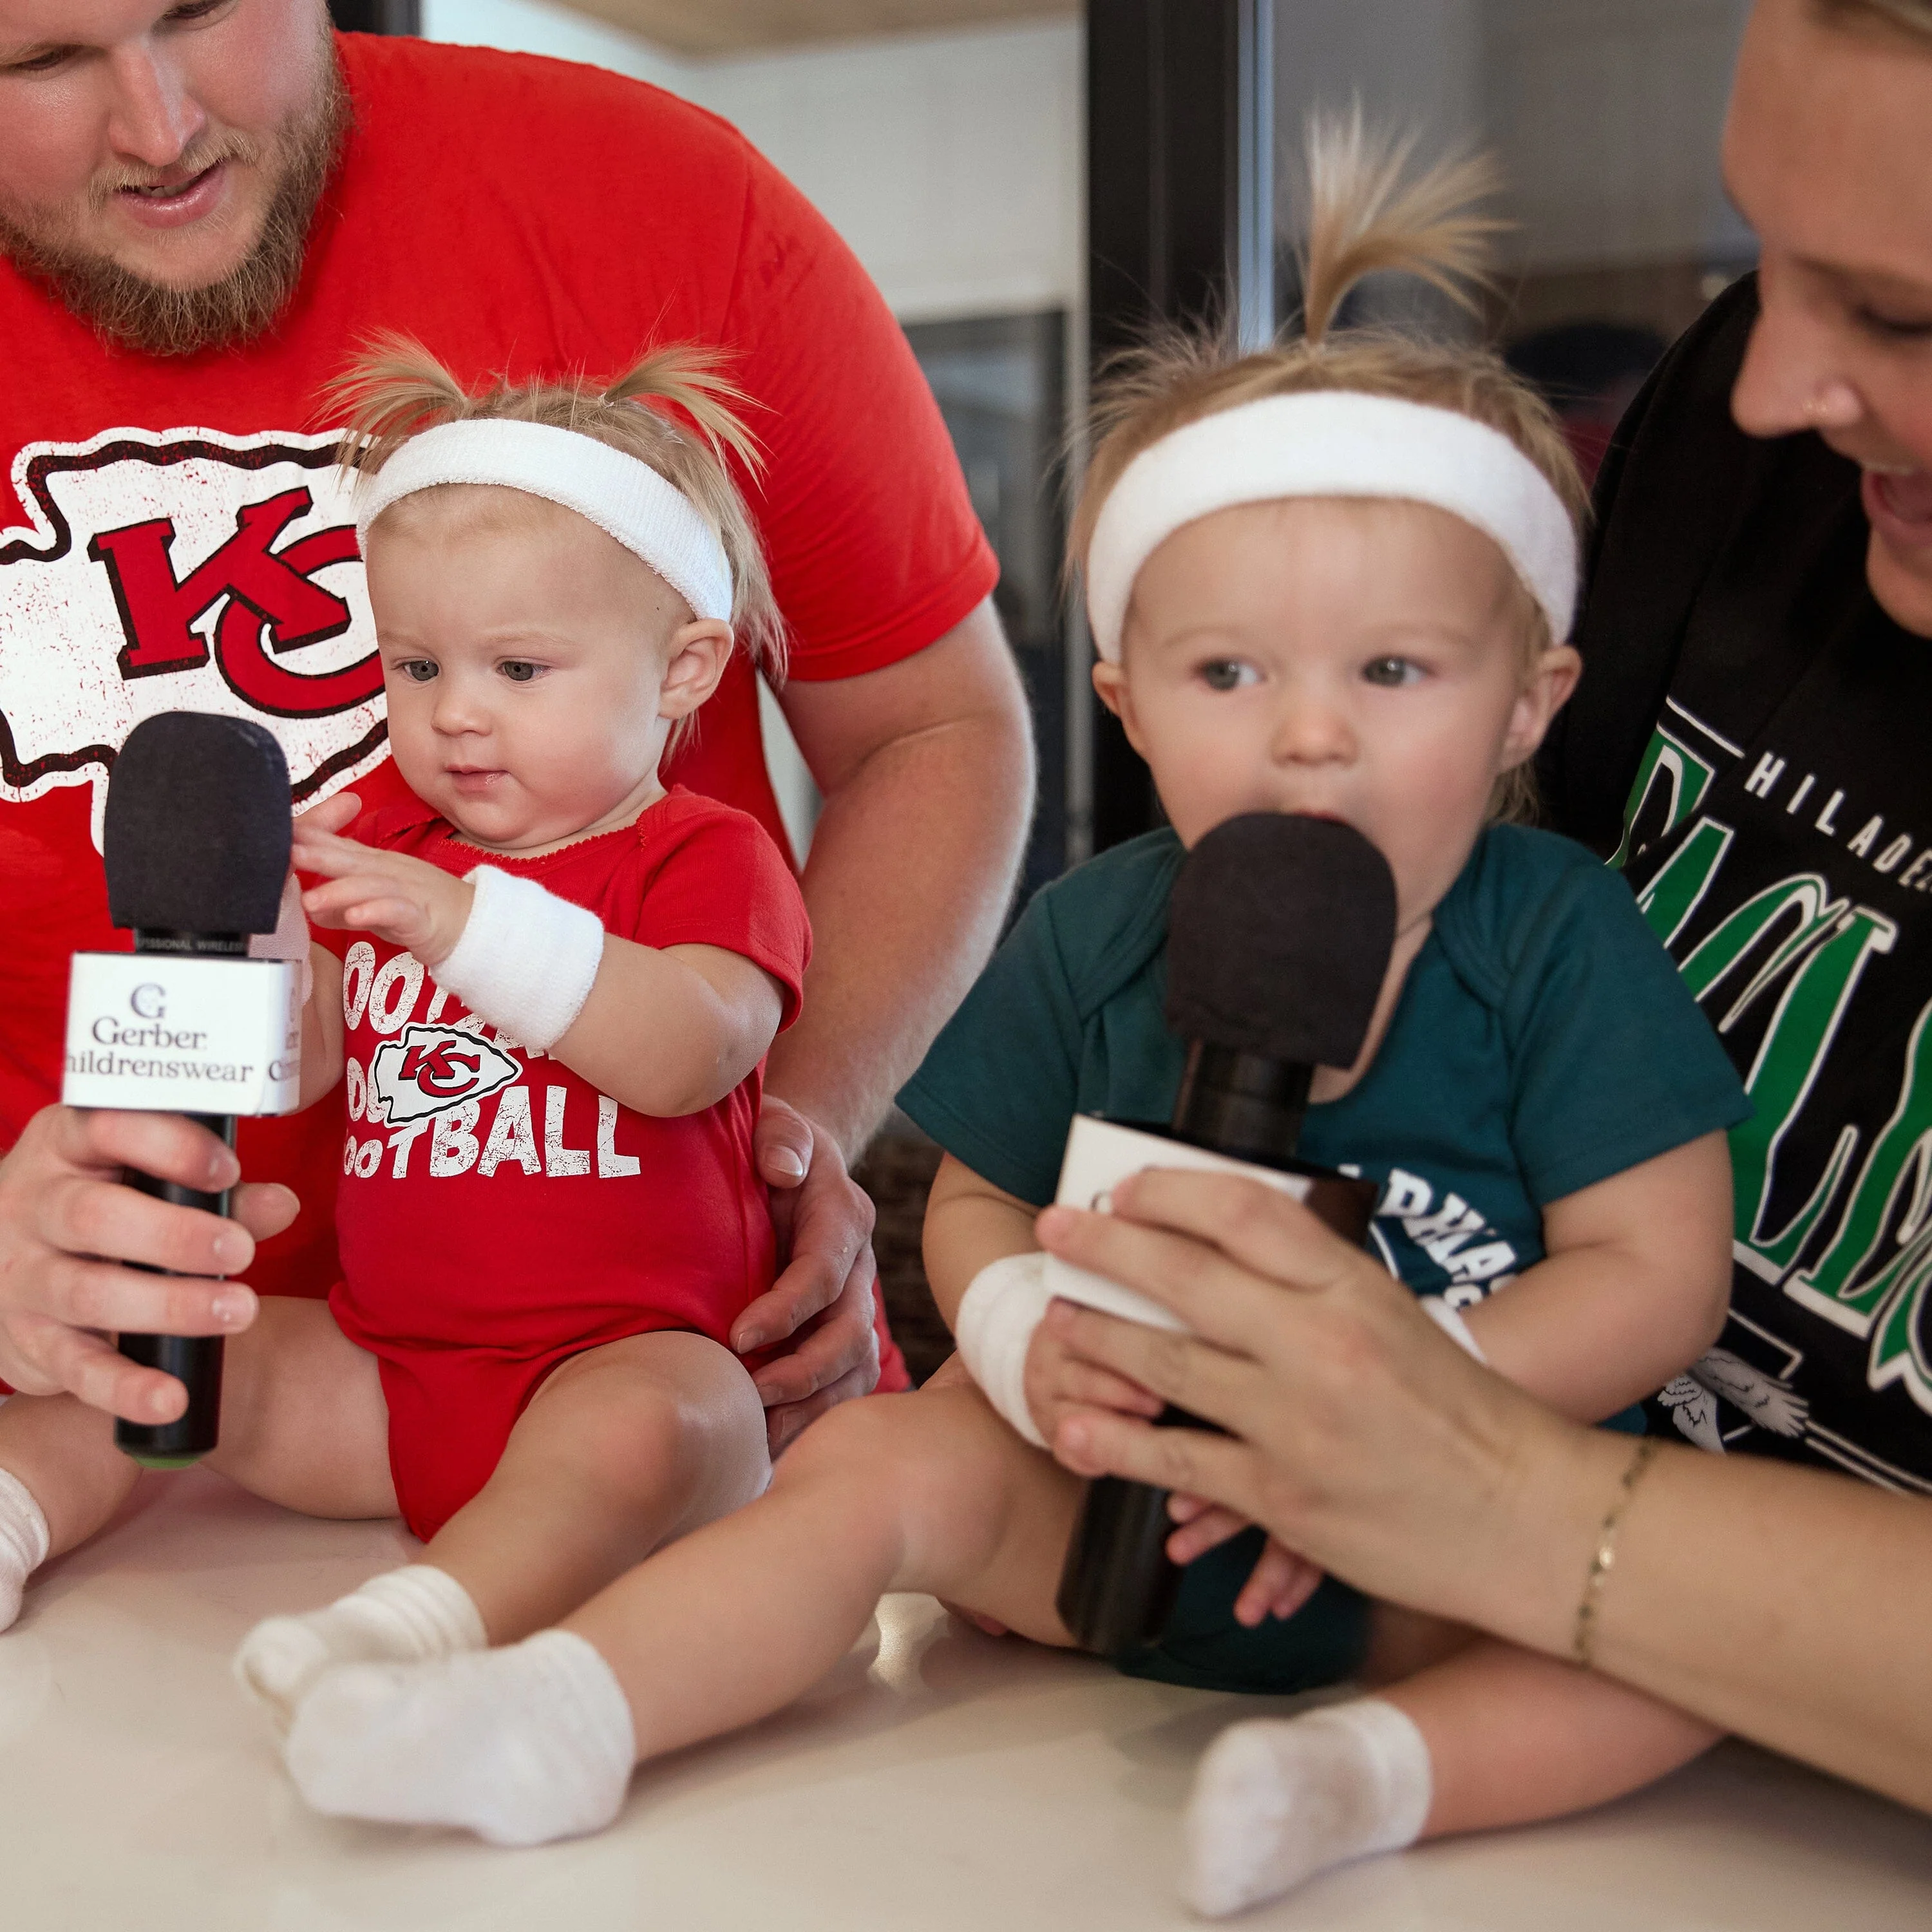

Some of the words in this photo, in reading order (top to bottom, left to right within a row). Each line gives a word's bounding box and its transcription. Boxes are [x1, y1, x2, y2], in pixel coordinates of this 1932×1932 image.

[87, 486, 386, 719] KC
[1744, 750, 1932, 894] HILADE
[130, 983, 166, 1019] G
[91, 1016, 207, 1050] Gerber
[398, 1039, 481, 1098] KC
